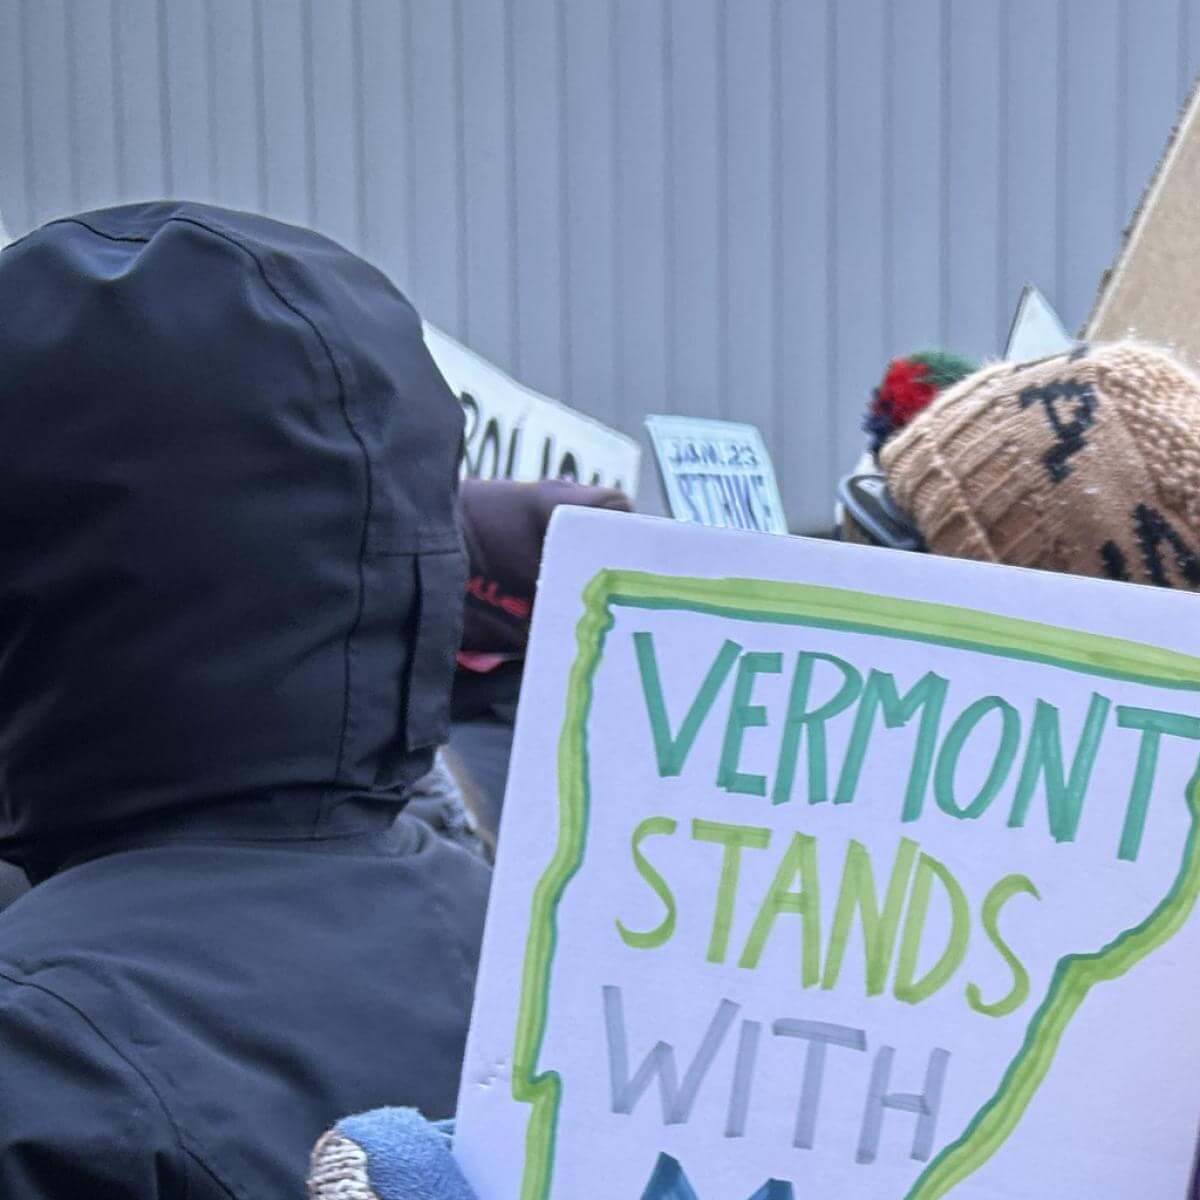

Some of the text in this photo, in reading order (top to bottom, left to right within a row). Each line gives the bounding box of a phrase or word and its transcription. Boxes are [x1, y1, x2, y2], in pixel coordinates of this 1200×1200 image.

[728, 444, 758, 466] 23
[615, 817, 1041, 1018] STANDS
[602, 985, 950, 1164] WITH
